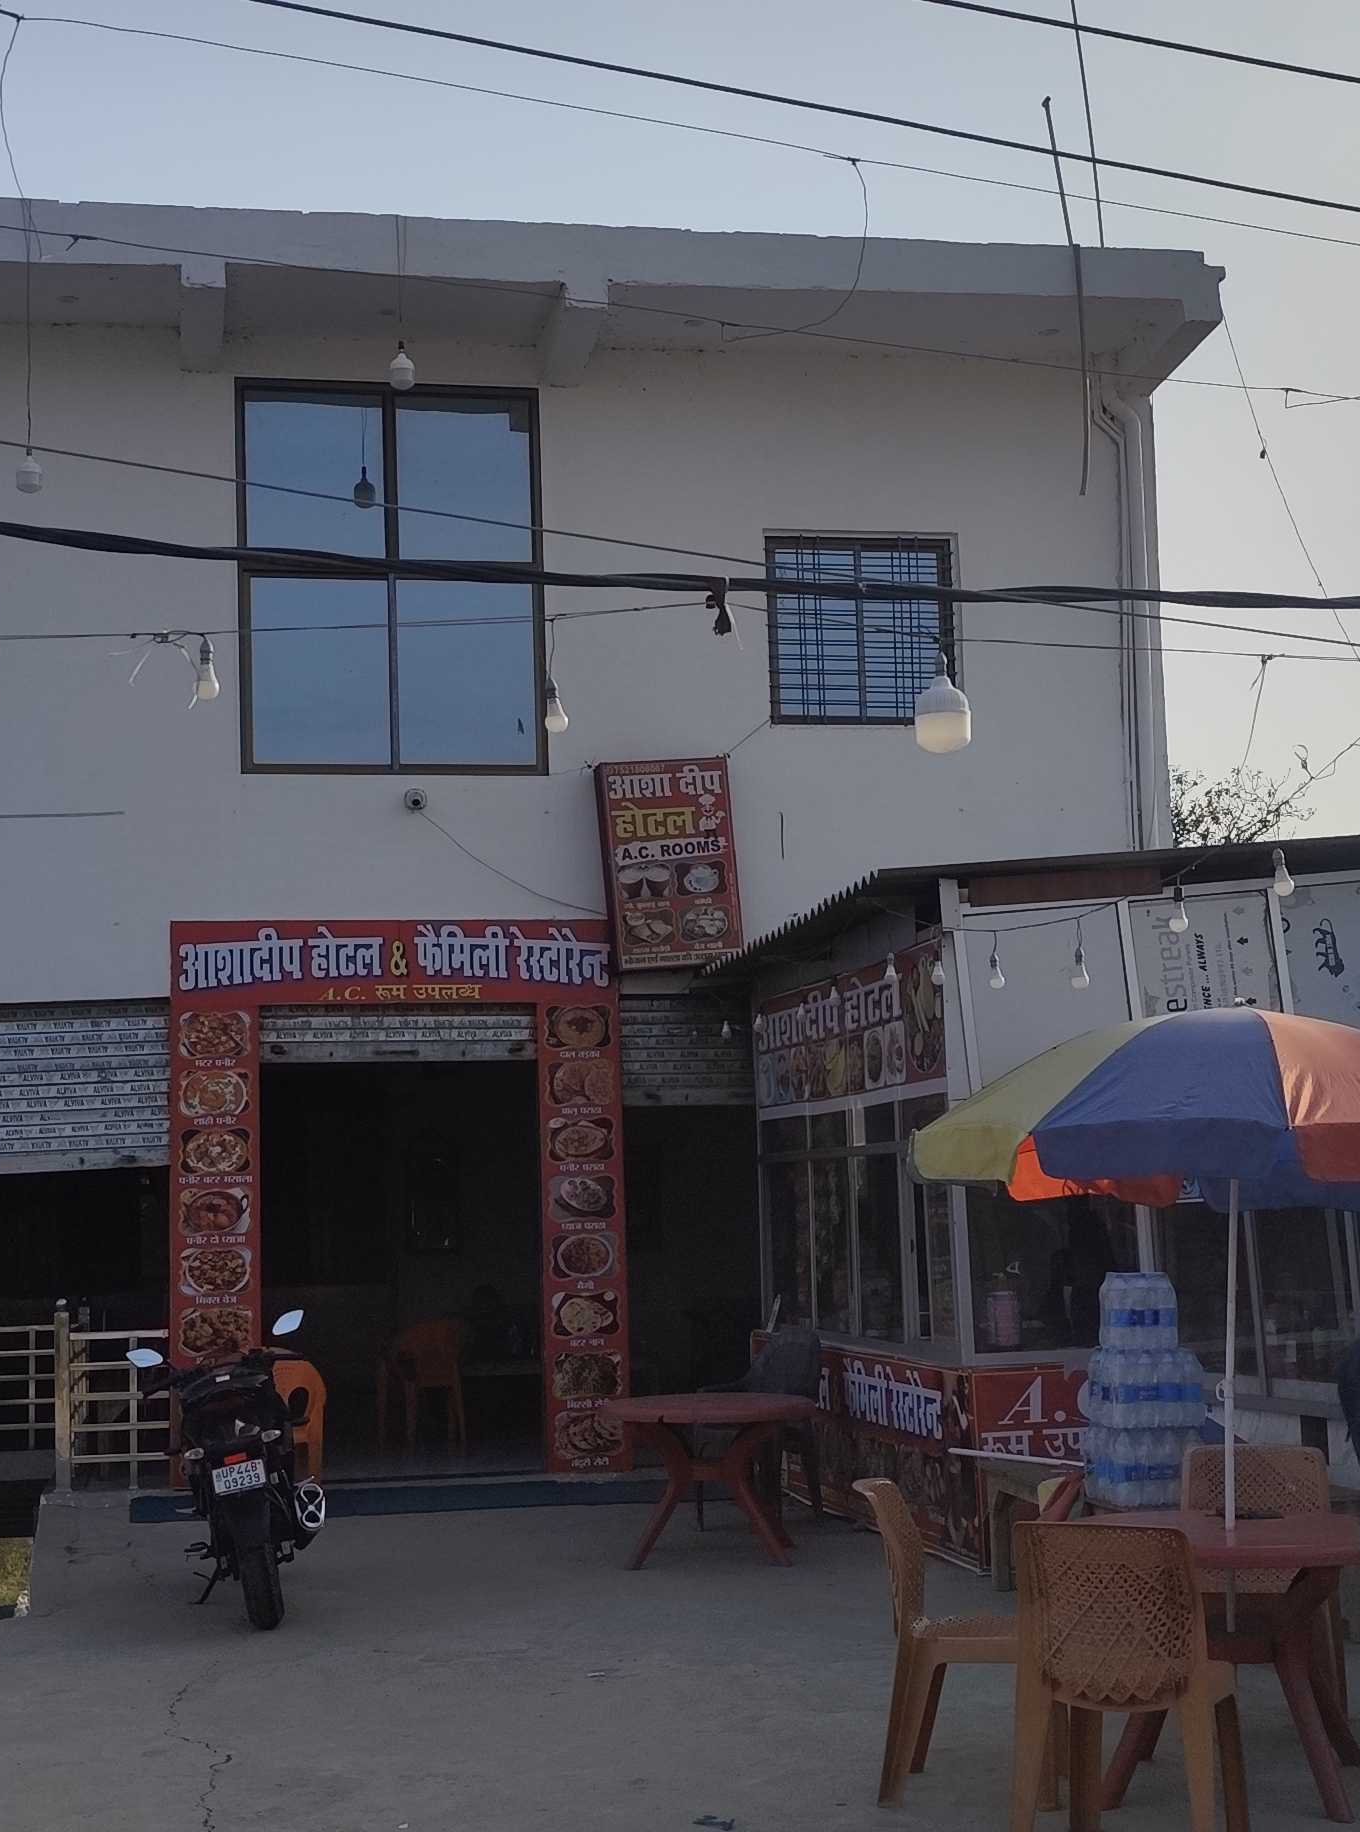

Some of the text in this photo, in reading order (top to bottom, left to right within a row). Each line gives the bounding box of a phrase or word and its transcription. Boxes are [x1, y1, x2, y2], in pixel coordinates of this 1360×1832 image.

[608, 765, 722, 799] आशा दीप
[610, 802, 696, 838] होटल
[621, 838, 722, 861] A.C. ROOMS
[178, 923, 610, 990] आशादीप होटल & फैमिली रेस्टोरेन्ट
[317, 983, 483, 1001] A.C. रूम उपलब्ध
[757, 988, 842, 1053] आशादीप
[843, 973, 903, 1033] होटल
